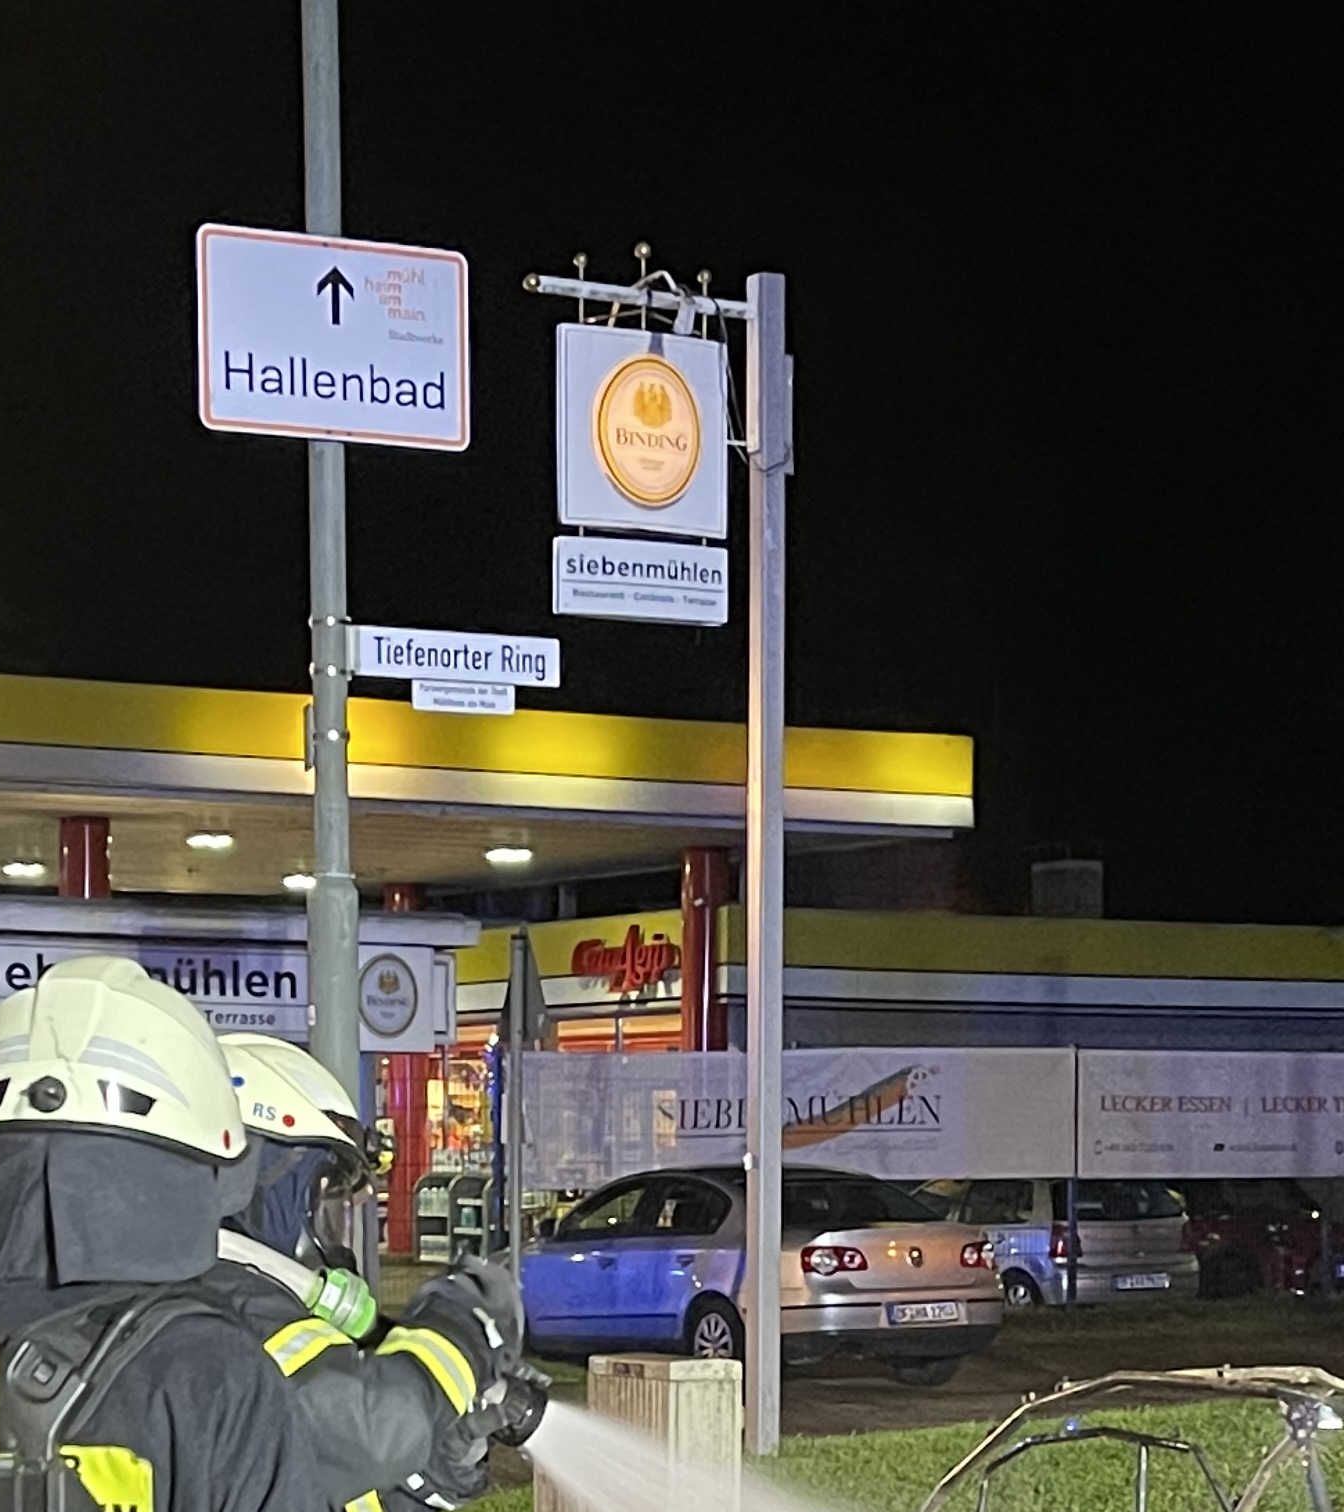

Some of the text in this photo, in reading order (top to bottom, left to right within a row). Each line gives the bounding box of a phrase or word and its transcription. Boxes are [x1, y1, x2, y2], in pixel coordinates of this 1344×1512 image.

[364, 276, 402, 295] heim
[387, 268, 425, 286] mühl
[387, 306, 426, 322] main
[223, 349, 446, 411] Hallenbad
[614, 426, 688, 452] BINDING
[565, 553, 723, 586] siebenmühlen
[372, 635, 546, 682] Tiefenorter Ring
[204, 1009, 276, 1026] Terrasse
[252, 1101, 277, 1122] RS
[1100, 1095, 1173, 1113] LECKER
[1177, 1095, 1233, 1113] ESSEN
[1261, 1095, 1330, 1113] LECKER
